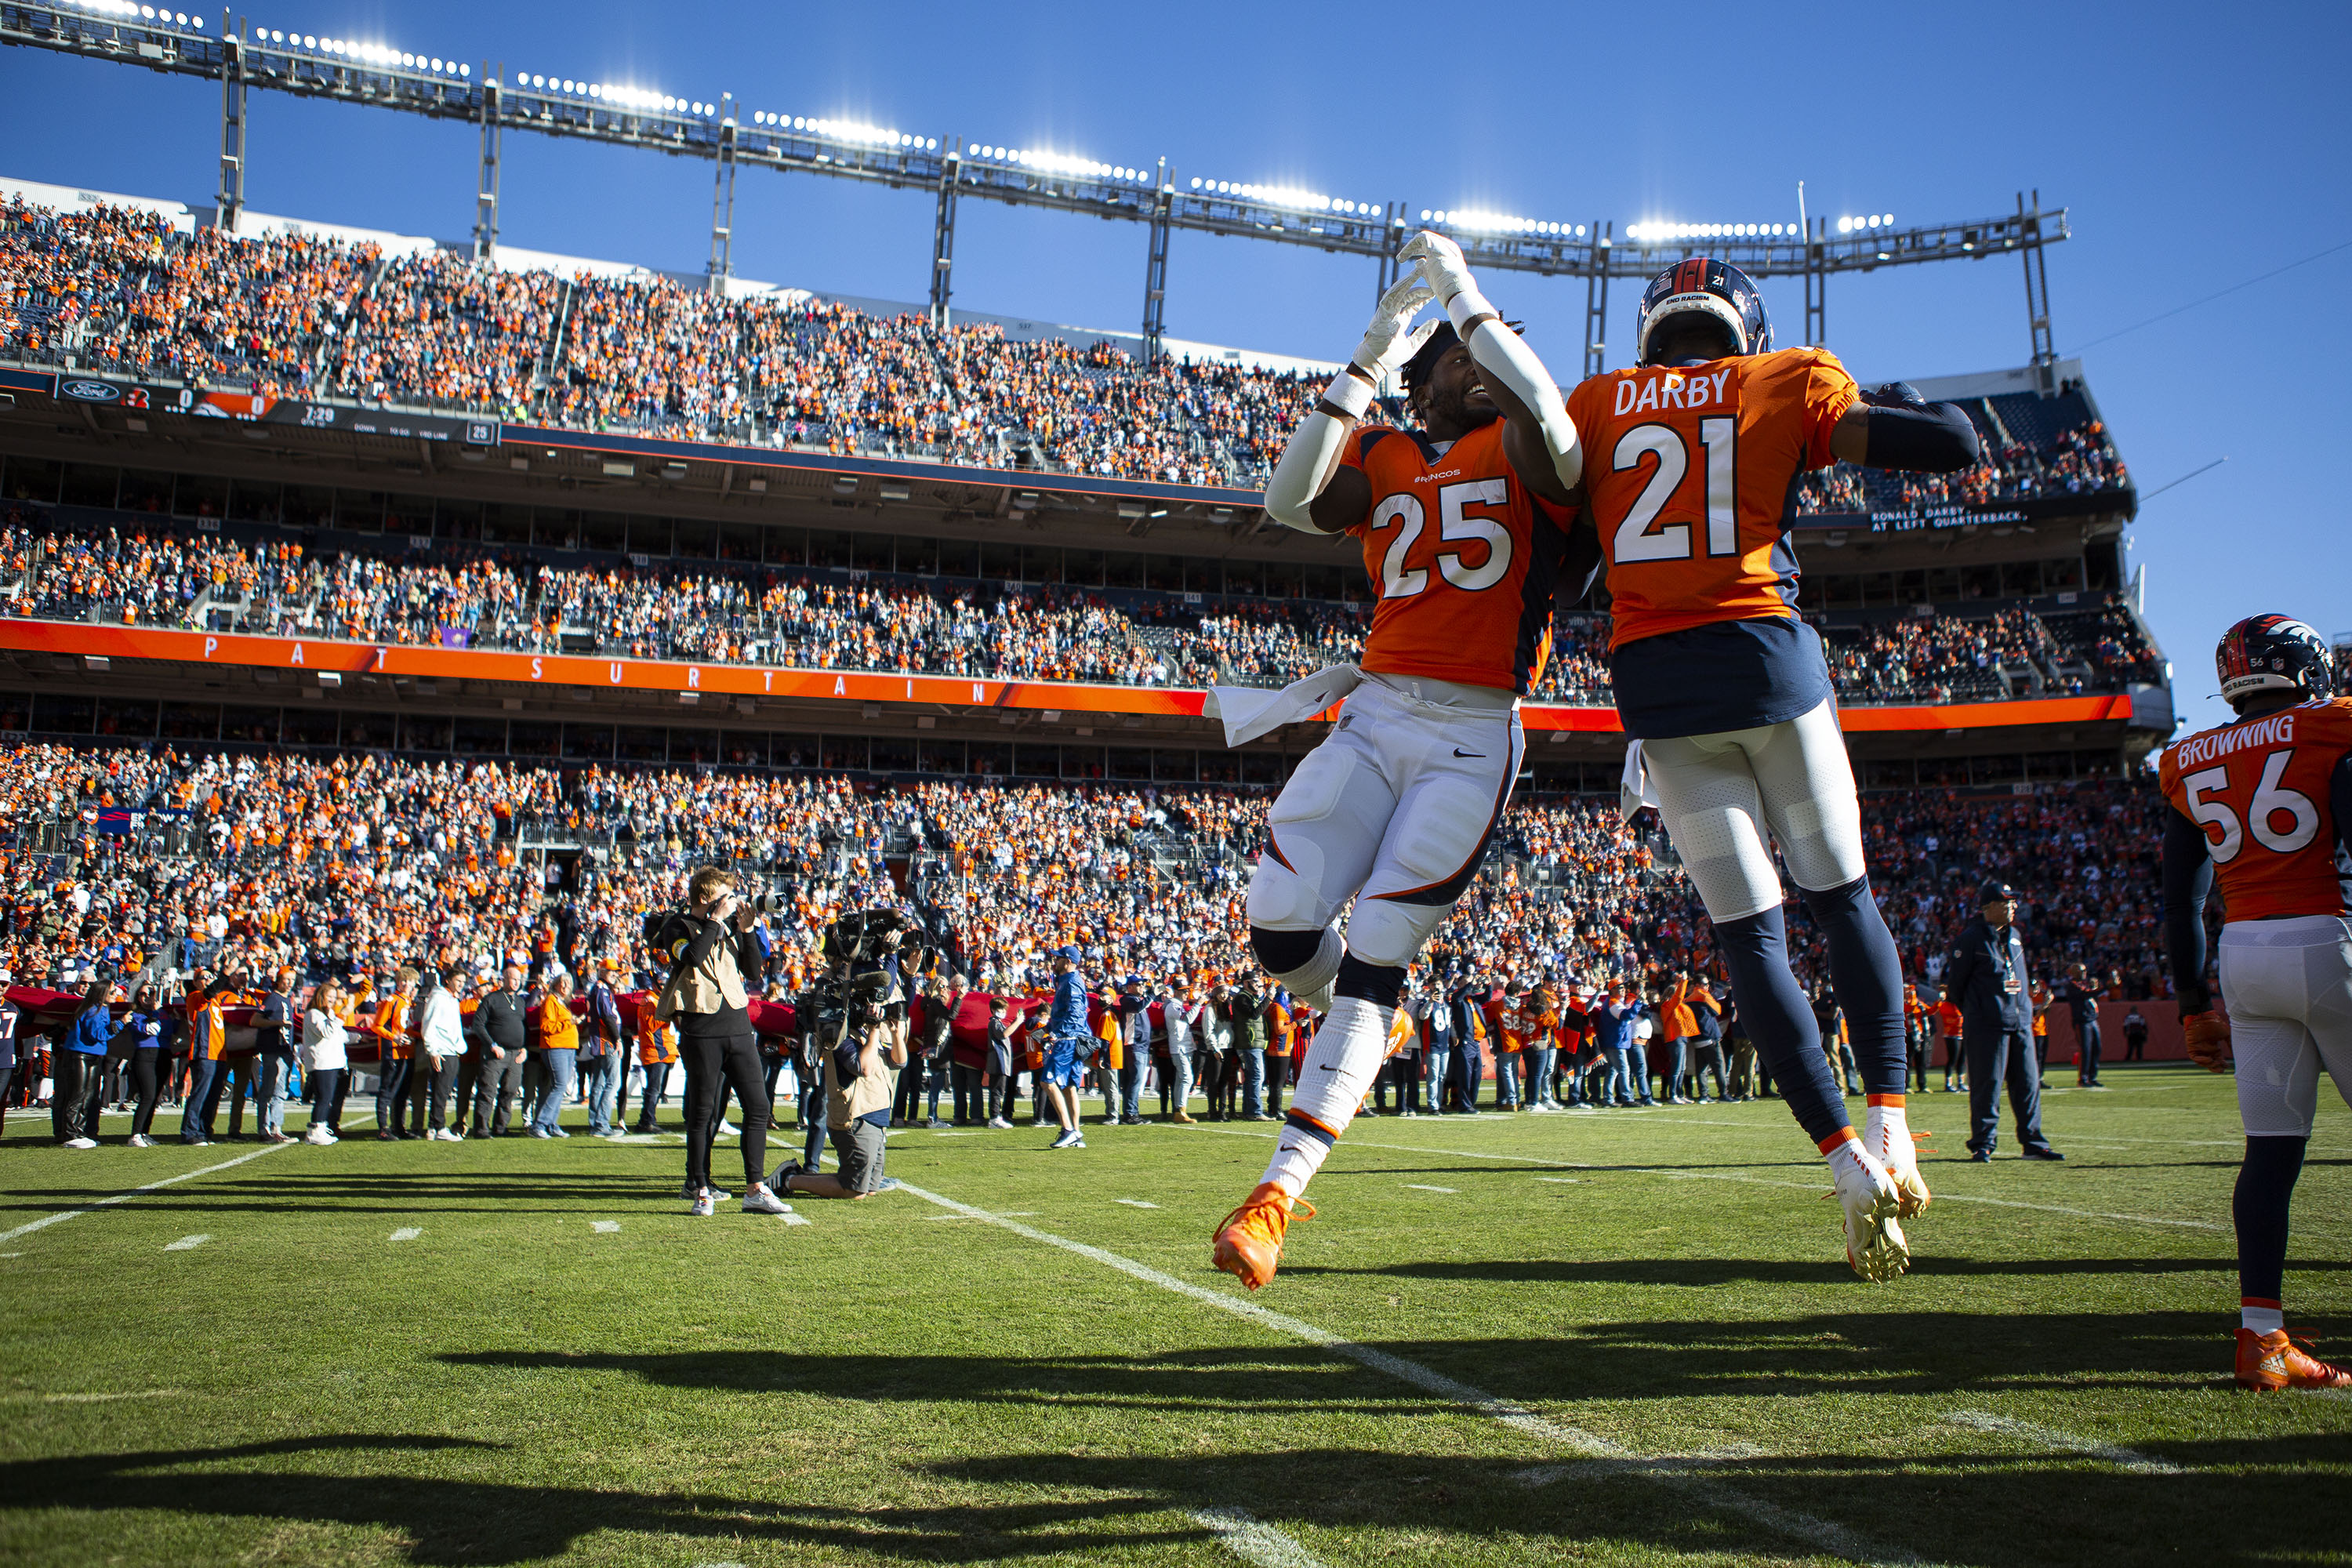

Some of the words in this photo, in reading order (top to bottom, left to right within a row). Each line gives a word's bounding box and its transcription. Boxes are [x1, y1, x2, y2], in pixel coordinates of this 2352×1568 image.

[1712, 276, 1724, 286] 21
[73, 382, 109, 398] Ford
[1614, 368, 1731, 416] DARBY
[180, 389, 193, 408] 0
[251, 395, 264, 416] 0
[354, 423, 376, 434] DOWN
[473, 426, 488, 440] 25
[1613, 414, 1740, 566] 21
[1871, 510, 1918, 522] RONALD
[1872, 522, 1887, 533] AT
[1895, 518, 1926, 532] LEFT
[1372, 475, 1515, 601] 25
[1185, 593, 1201, 603] 341
[2250, 657, 2264, 666] 56
[205, 636, 388, 670] PAT
[530, 658, 985, 703] SURTAIN
[2233, 677, 2265, 688] RACISM
[2178, 715, 2294, 770] BROWNING
[2181, 746, 2321, 865] 56
[2259, 1362, 2289, 1377] adidas
